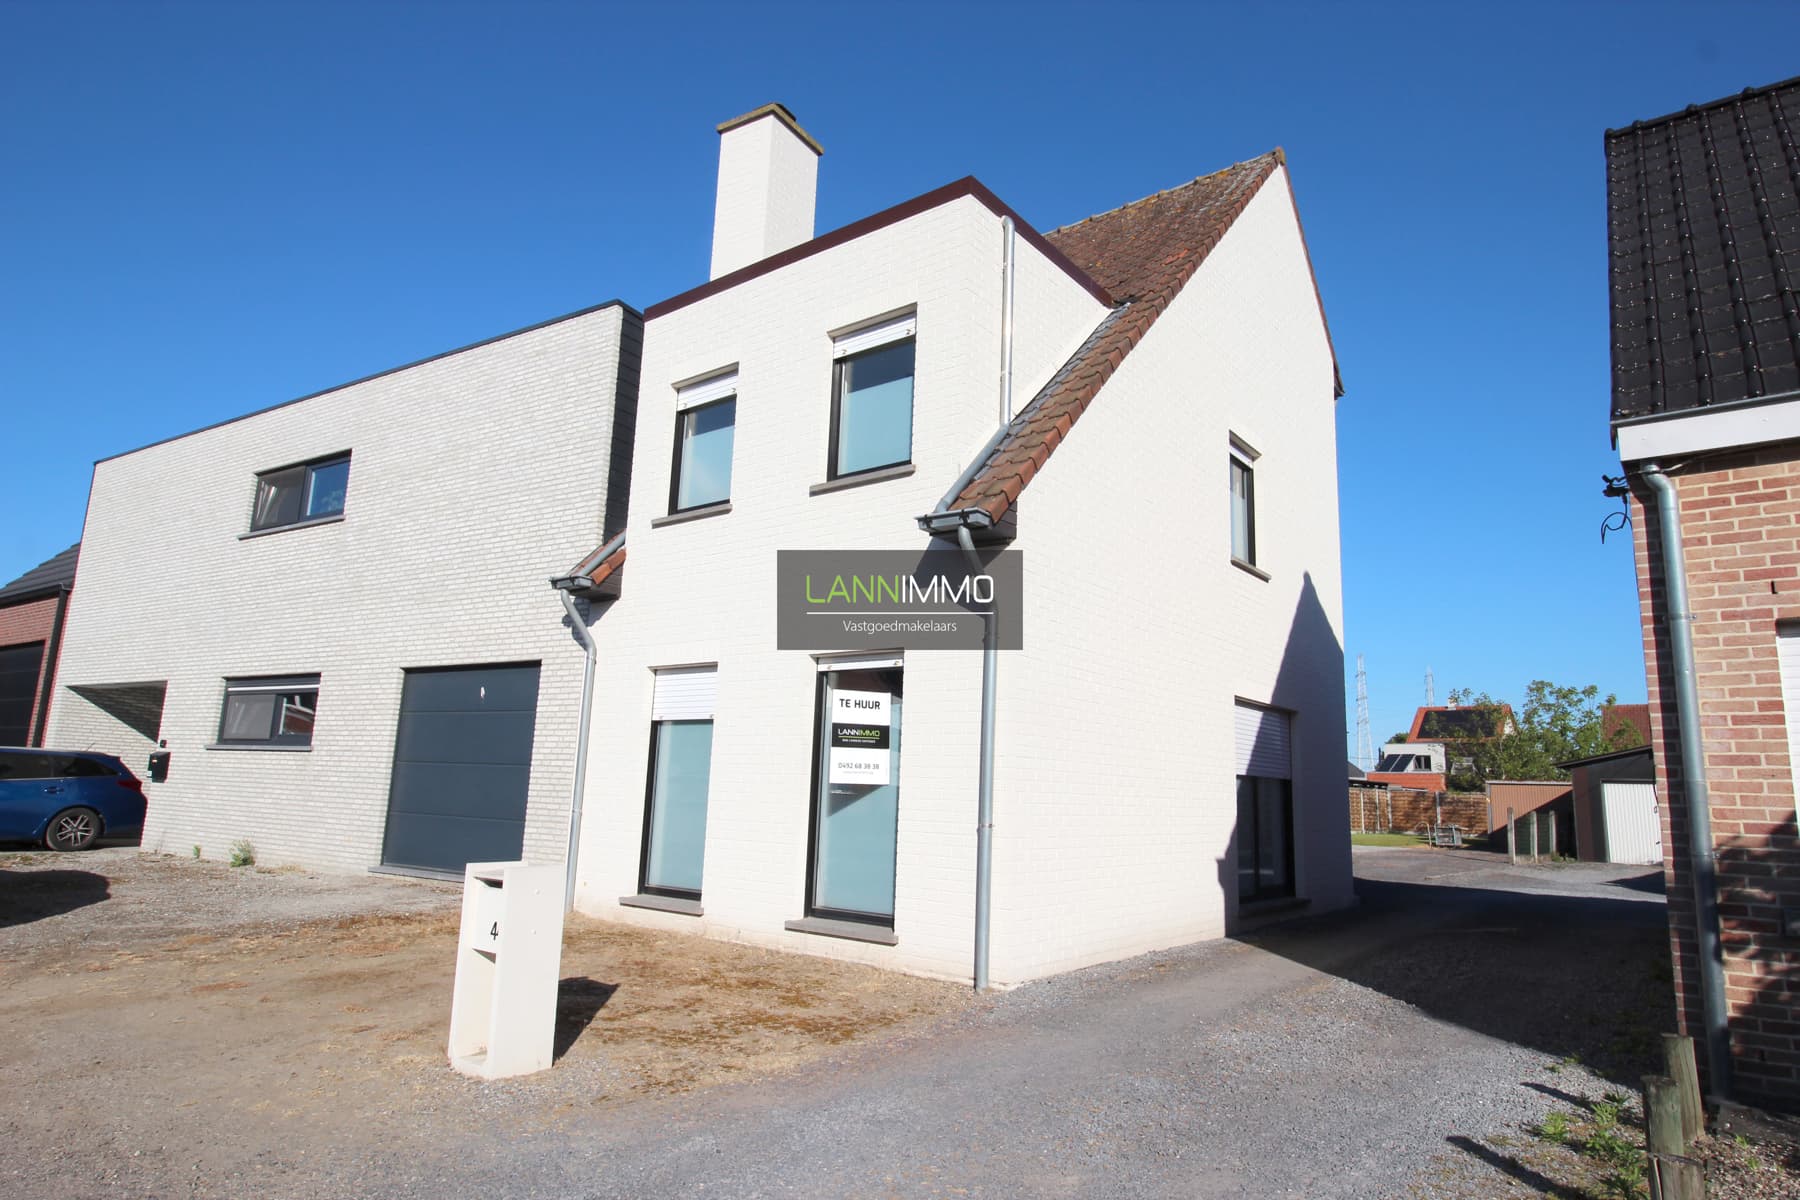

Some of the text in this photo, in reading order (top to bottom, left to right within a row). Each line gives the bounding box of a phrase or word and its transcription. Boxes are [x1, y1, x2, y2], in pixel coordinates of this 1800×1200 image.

[839, 698, 881, 710] TE HUUR
[838, 728, 880, 737] LANNIMMO
[490, 921, 499, 941] 4
